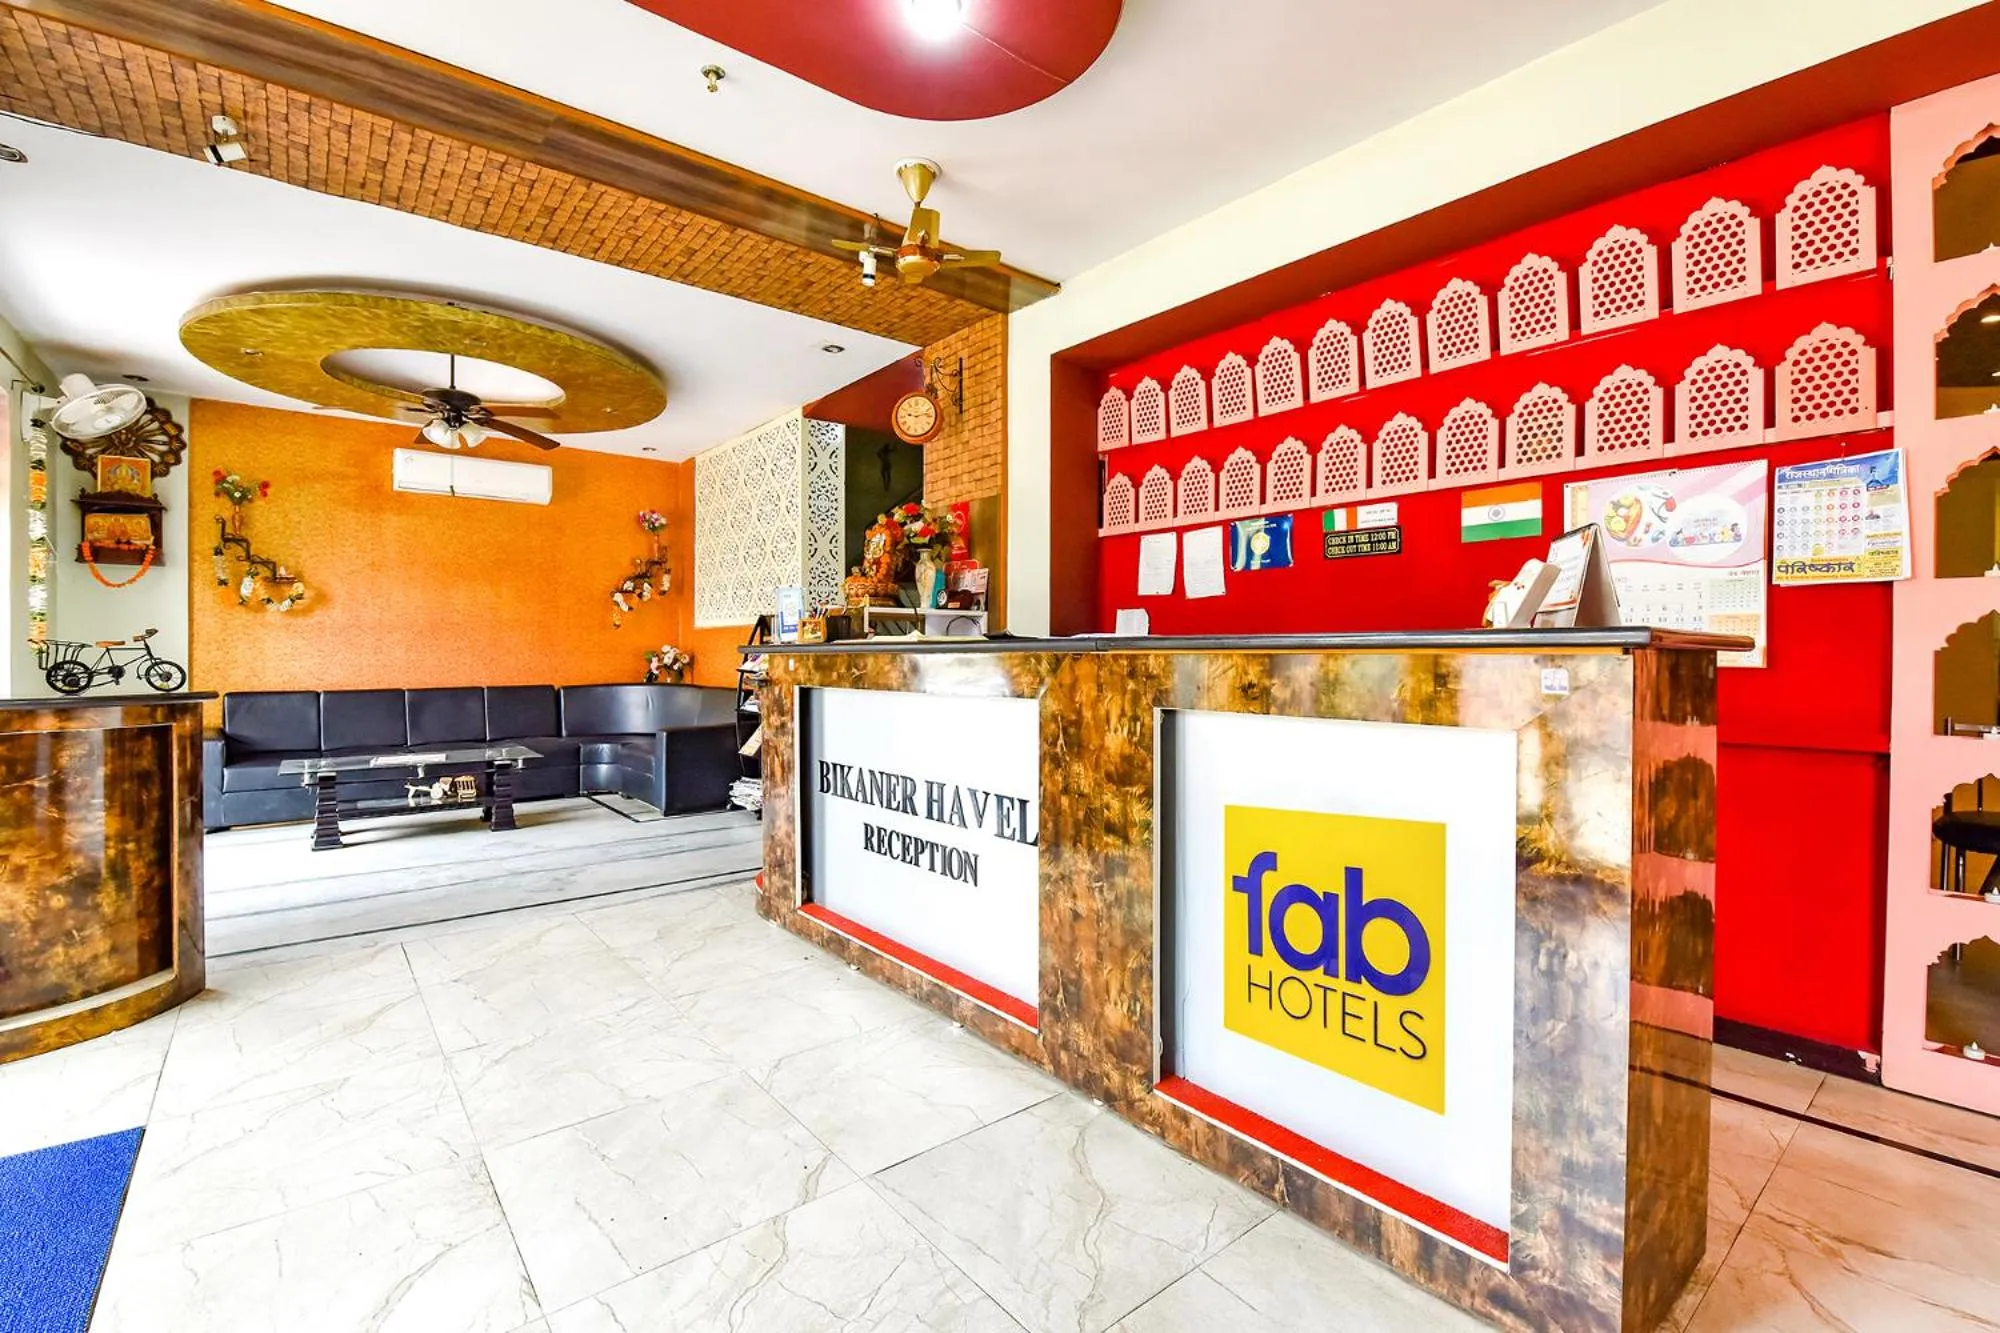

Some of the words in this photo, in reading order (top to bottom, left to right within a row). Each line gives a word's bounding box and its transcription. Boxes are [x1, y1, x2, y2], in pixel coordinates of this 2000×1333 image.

[1327, 545, 1346, 555] CHECK
[1328, 536, 1347, 545] CHECK
[818, 759, 918, 816] BIKANER
[863, 822, 980, 887] RECEPTION
[1232, 851, 1431, 997] fab
[1247, 964, 1428, 1061] HOTELS
